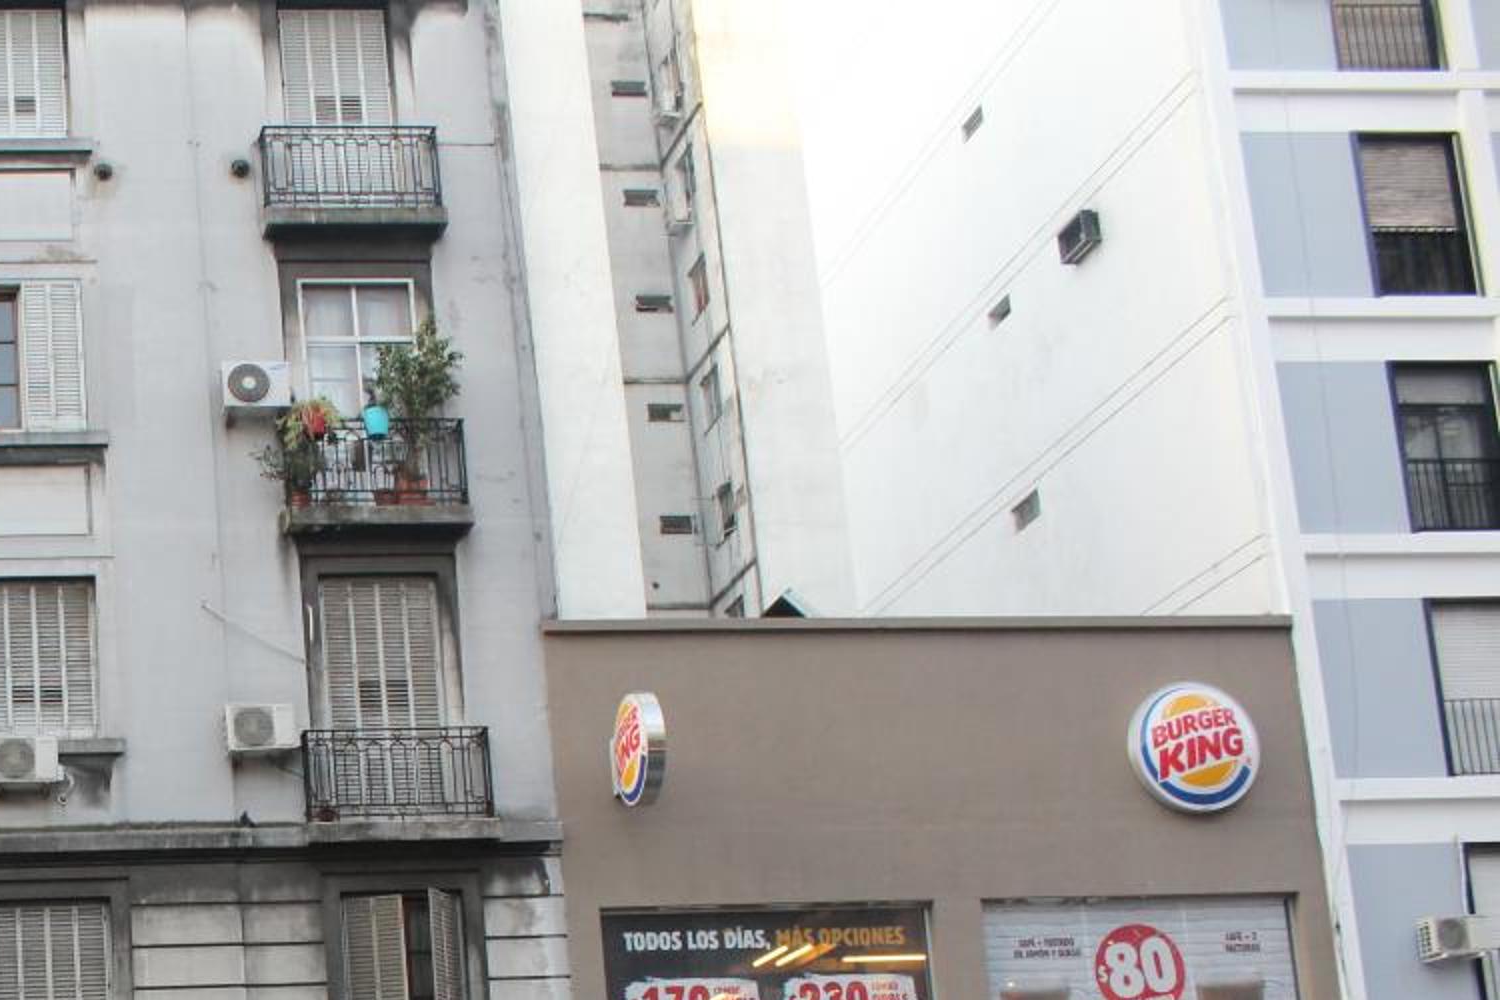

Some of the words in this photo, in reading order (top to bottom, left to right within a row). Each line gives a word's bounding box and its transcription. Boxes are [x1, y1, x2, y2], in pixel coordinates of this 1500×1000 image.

[1151, 707, 1237, 748] BURGER
[1159, 728, 1244, 780] KING
[623, 931, 682, 951] TODOS
[688, 930, 721, 949] LOS
[724, 925, 771, 951] DÍAS,
[776, 926, 814, 947] MÁS
[819, 927, 905, 947] OPCIONES
